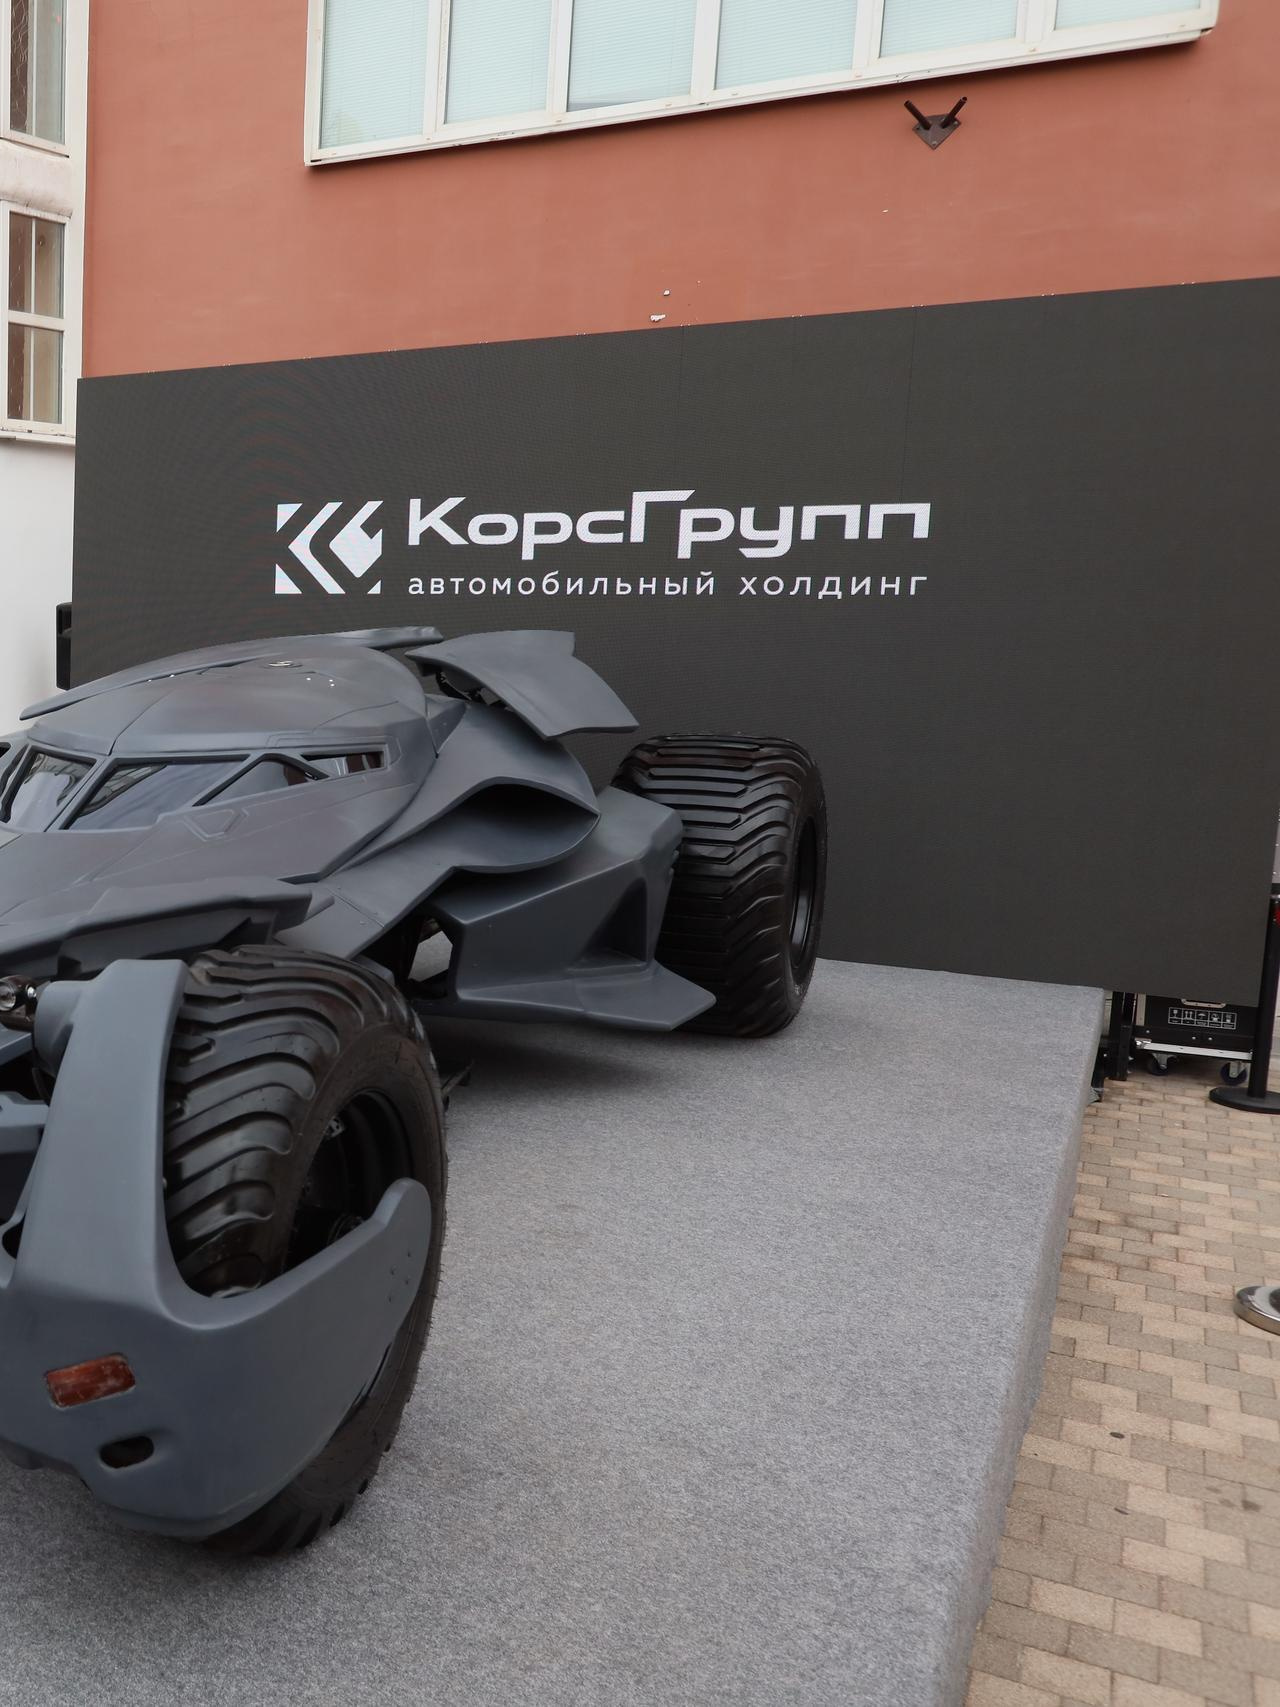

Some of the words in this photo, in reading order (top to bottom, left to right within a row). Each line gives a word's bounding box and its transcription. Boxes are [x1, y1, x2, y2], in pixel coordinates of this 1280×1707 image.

[408, 489, 931, 560] КорсГрупп
[408, 570, 716, 597] автомобильный
[739, 575, 929, 600] холдинг
